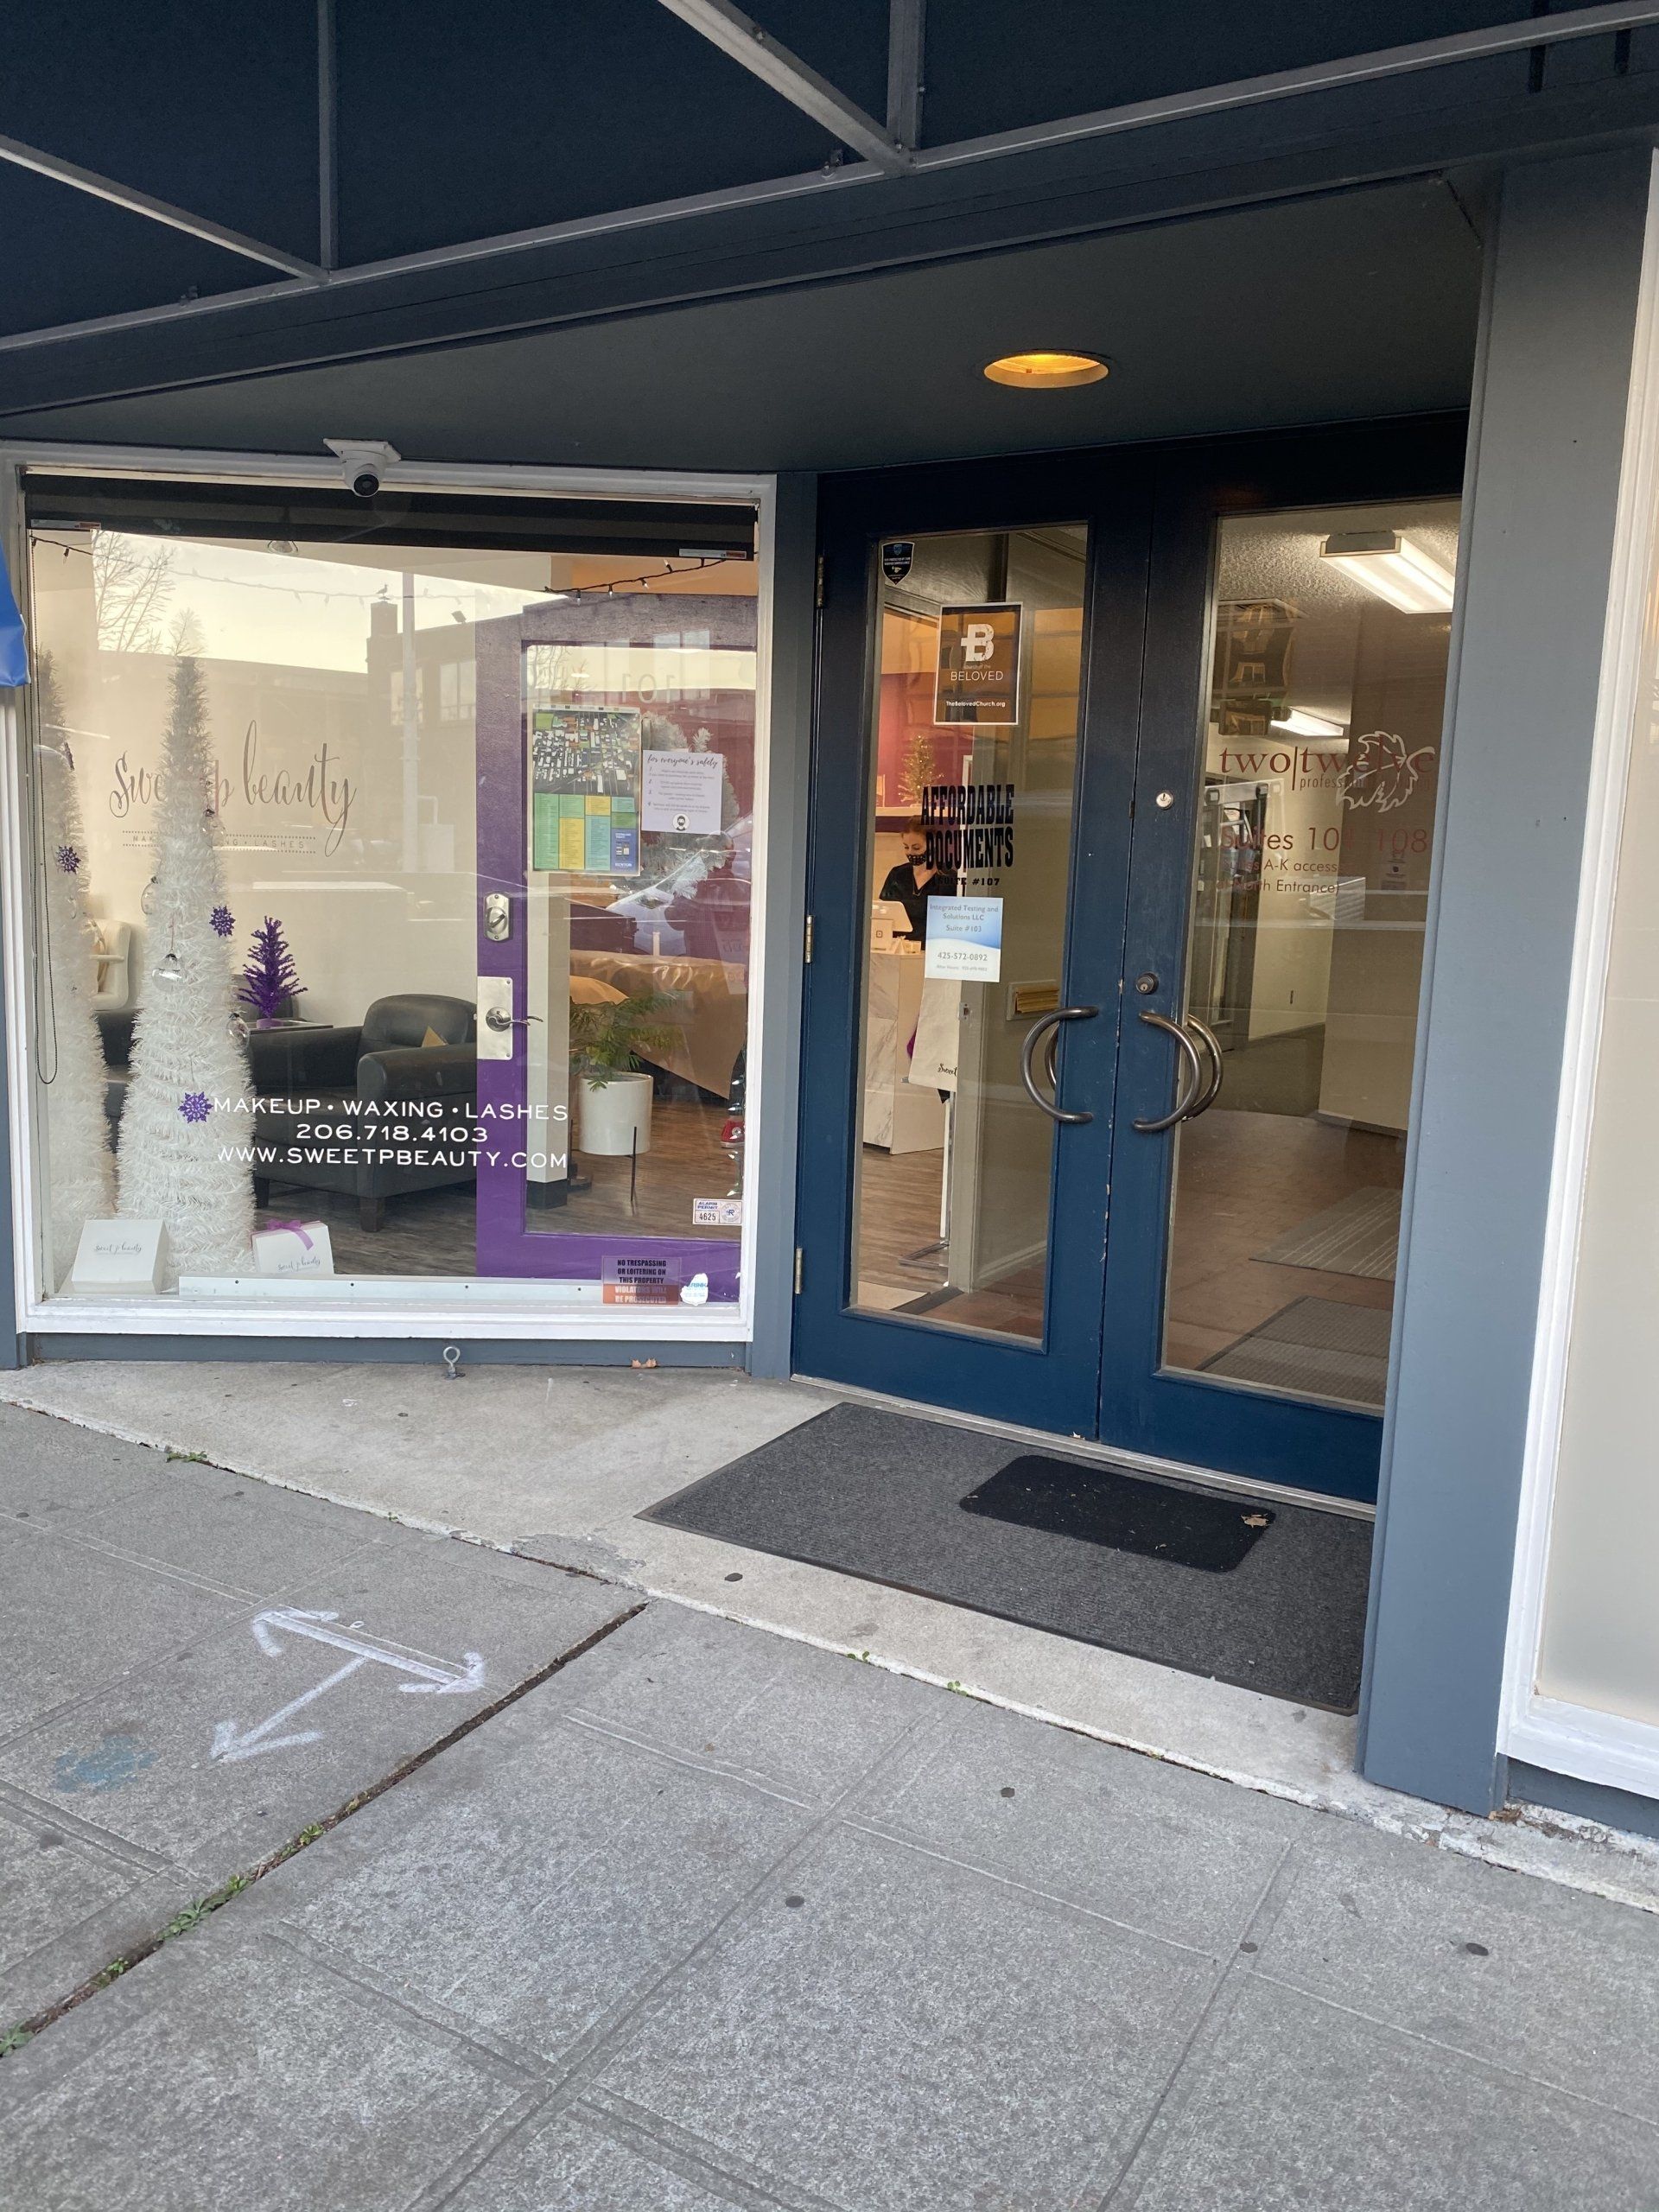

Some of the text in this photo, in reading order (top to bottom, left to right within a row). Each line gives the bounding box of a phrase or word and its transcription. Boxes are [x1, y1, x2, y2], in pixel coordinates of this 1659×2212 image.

[950, 671, 1004, 681] BELOVED
[243, 720, 357, 857] beauty
[920, 784, 1015, 826] AFFORDABLE
[925, 826, 1014, 871] DOCUMENTS
[1264, 859, 1289, 871] A-K
[930, 904, 962, 912] Integrated
[938, 951, 988, 961] 425-572-0892
[213, 1096, 569, 1122] MAKEUP WAXING LASHES
[296, 1123, 488, 1142] 206.718.4103
[217, 1146, 568, 1169] WWW.SWEETPBEAUTY.COM
[699, 1212, 716, 1221] 4625
